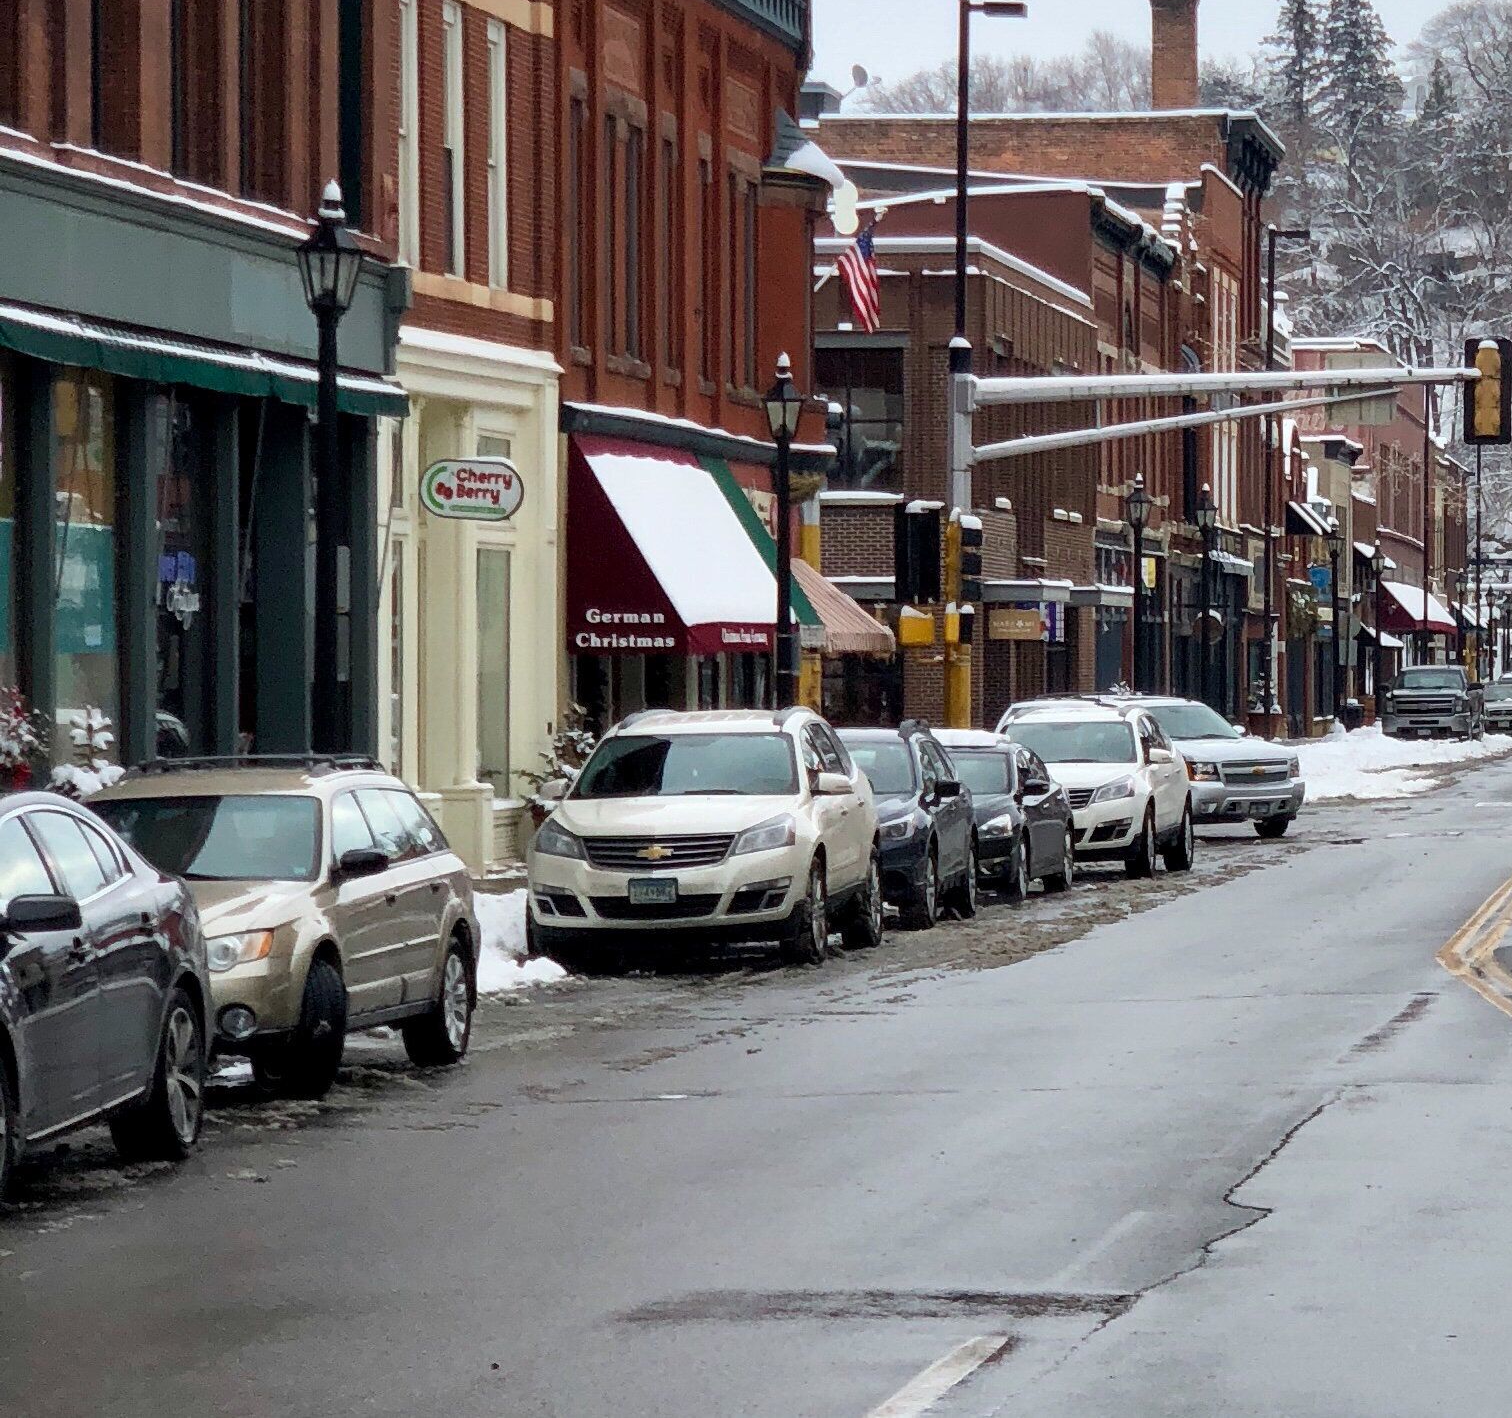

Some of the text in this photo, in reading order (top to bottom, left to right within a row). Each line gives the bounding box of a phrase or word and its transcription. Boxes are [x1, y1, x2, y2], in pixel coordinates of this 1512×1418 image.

[456, 467, 513, 491] Cherry
[456, 483, 501, 506] Berry
[585, 608, 666, 624] German
[575, 632, 676, 648] Christmas
